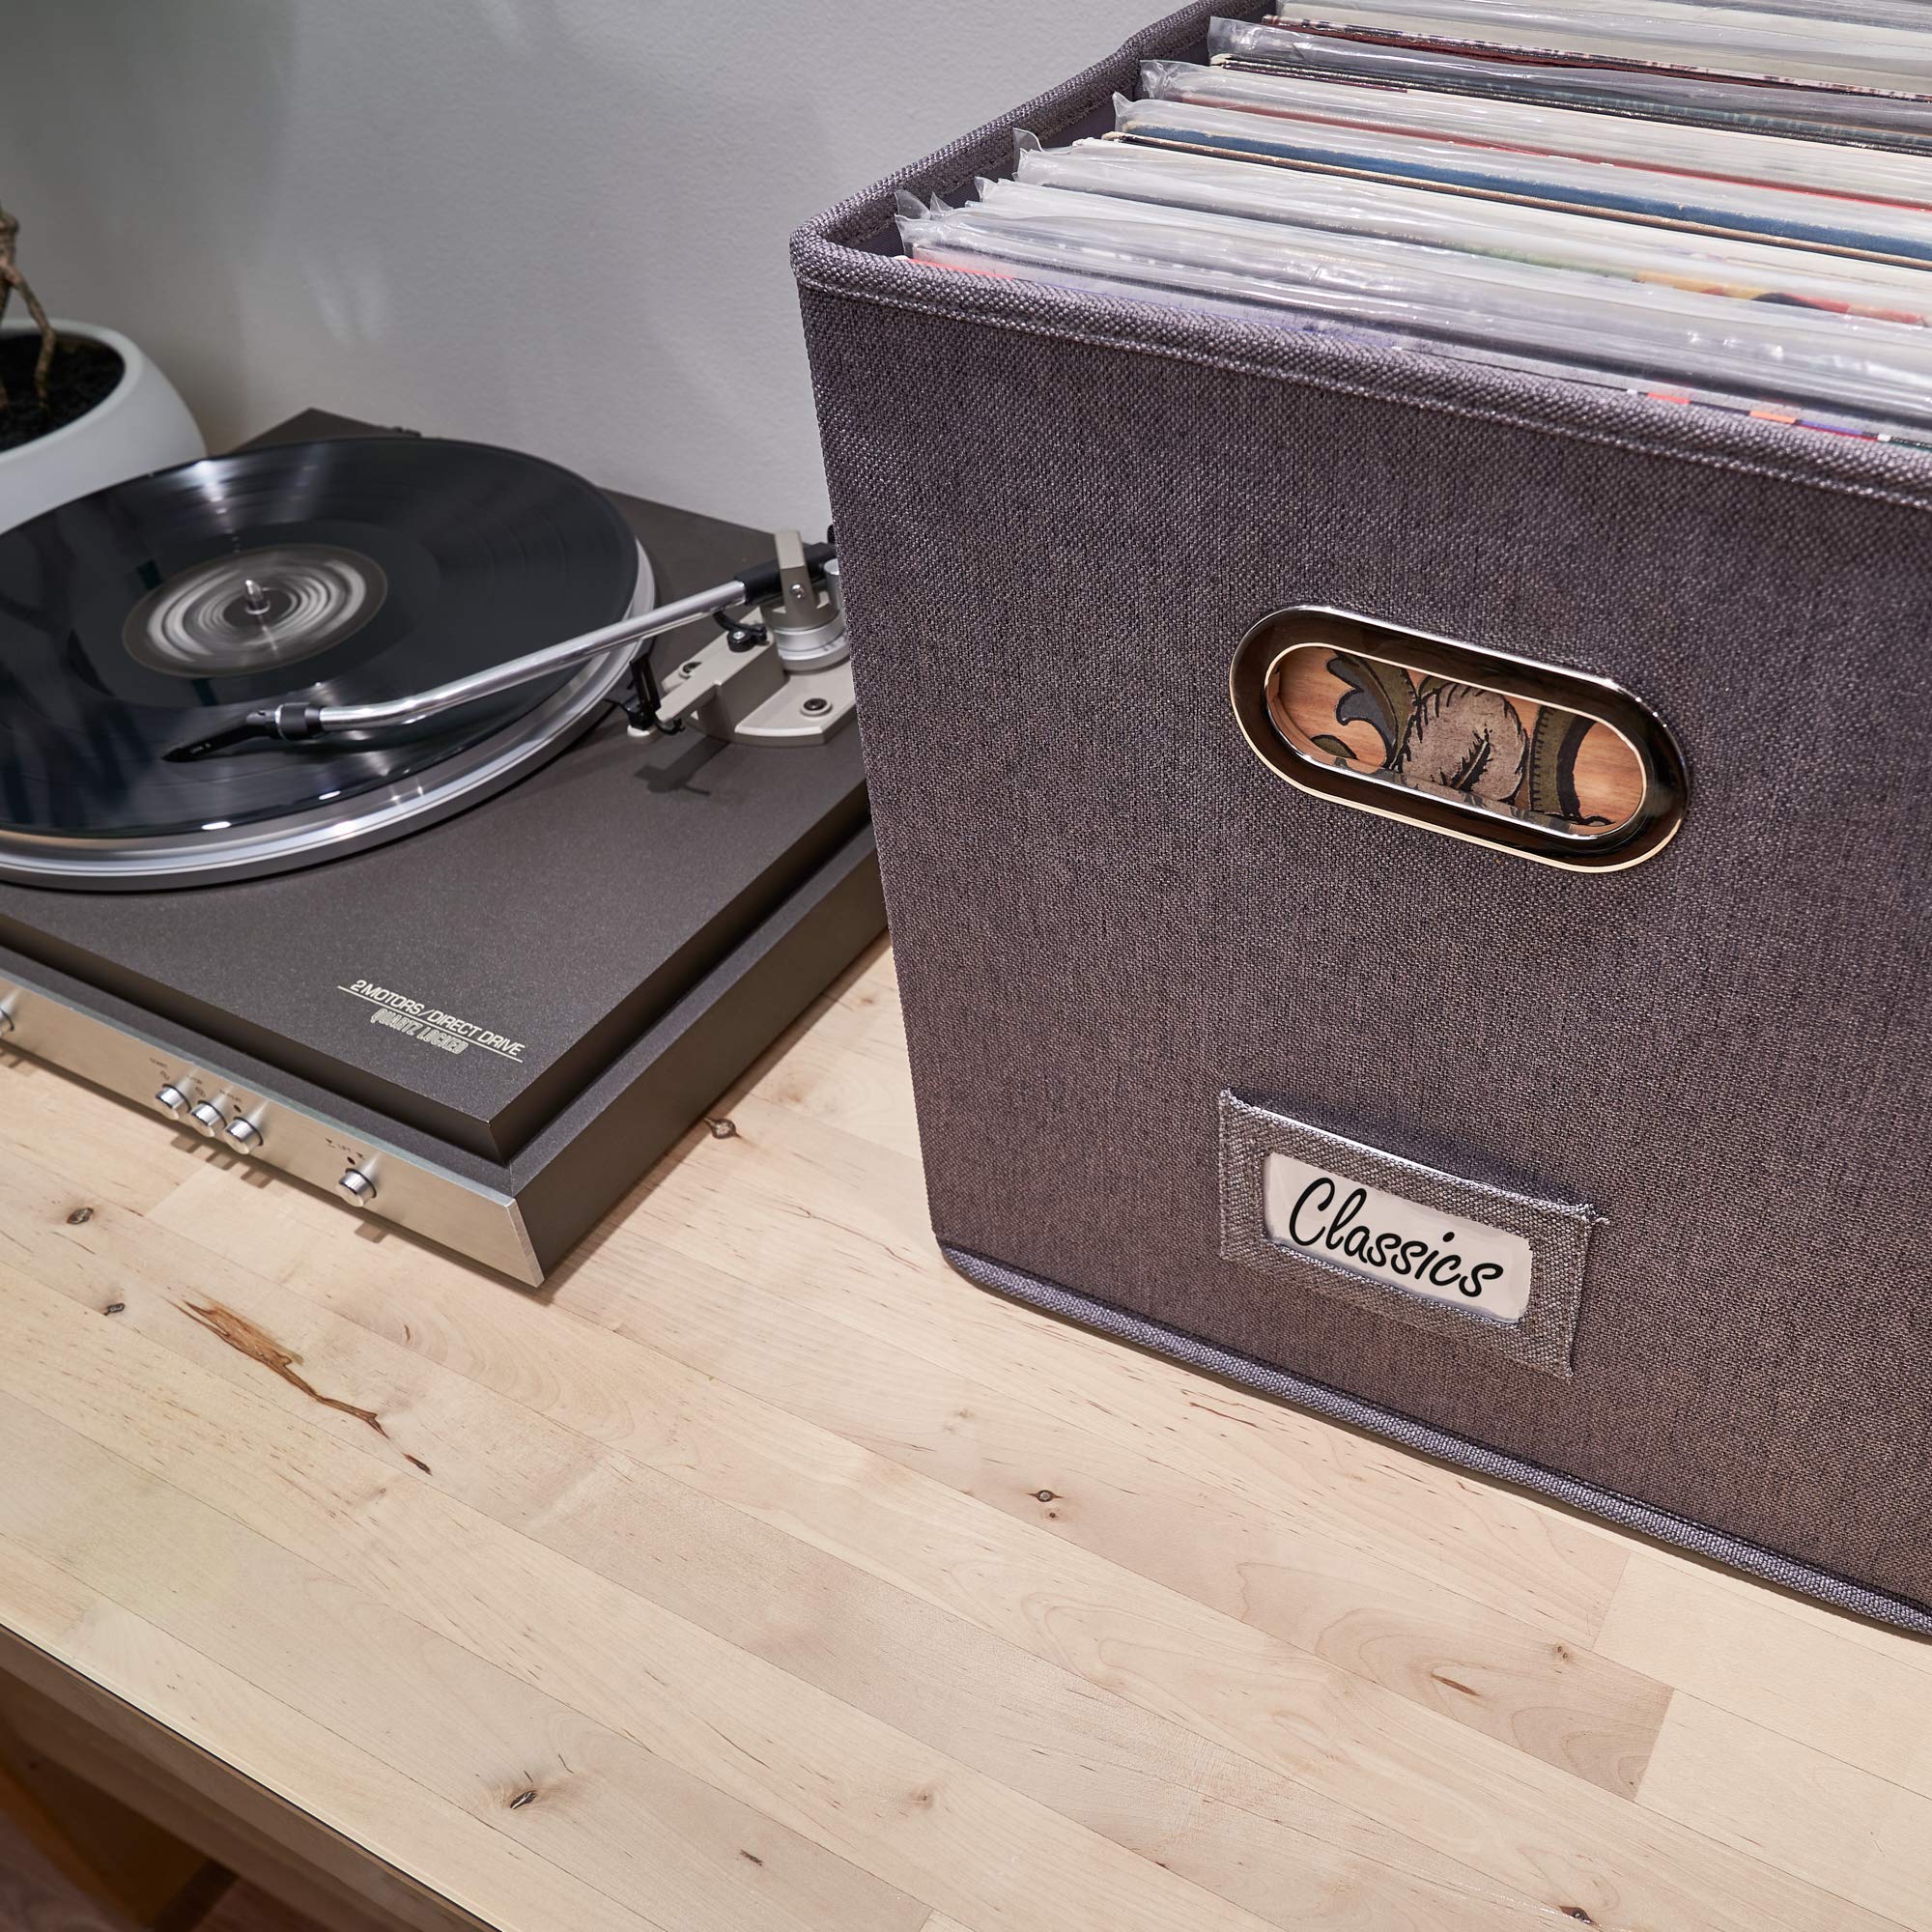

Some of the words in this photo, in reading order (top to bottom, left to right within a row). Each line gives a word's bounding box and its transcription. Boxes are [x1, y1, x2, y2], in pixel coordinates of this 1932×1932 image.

[370, 1008, 423, 1037] QUARTZ
[416, 1026, 469, 1055] LOCKED
[477, 1030, 526, 1056] DRIVE
[1289, 1177, 1504, 1297] Classics
